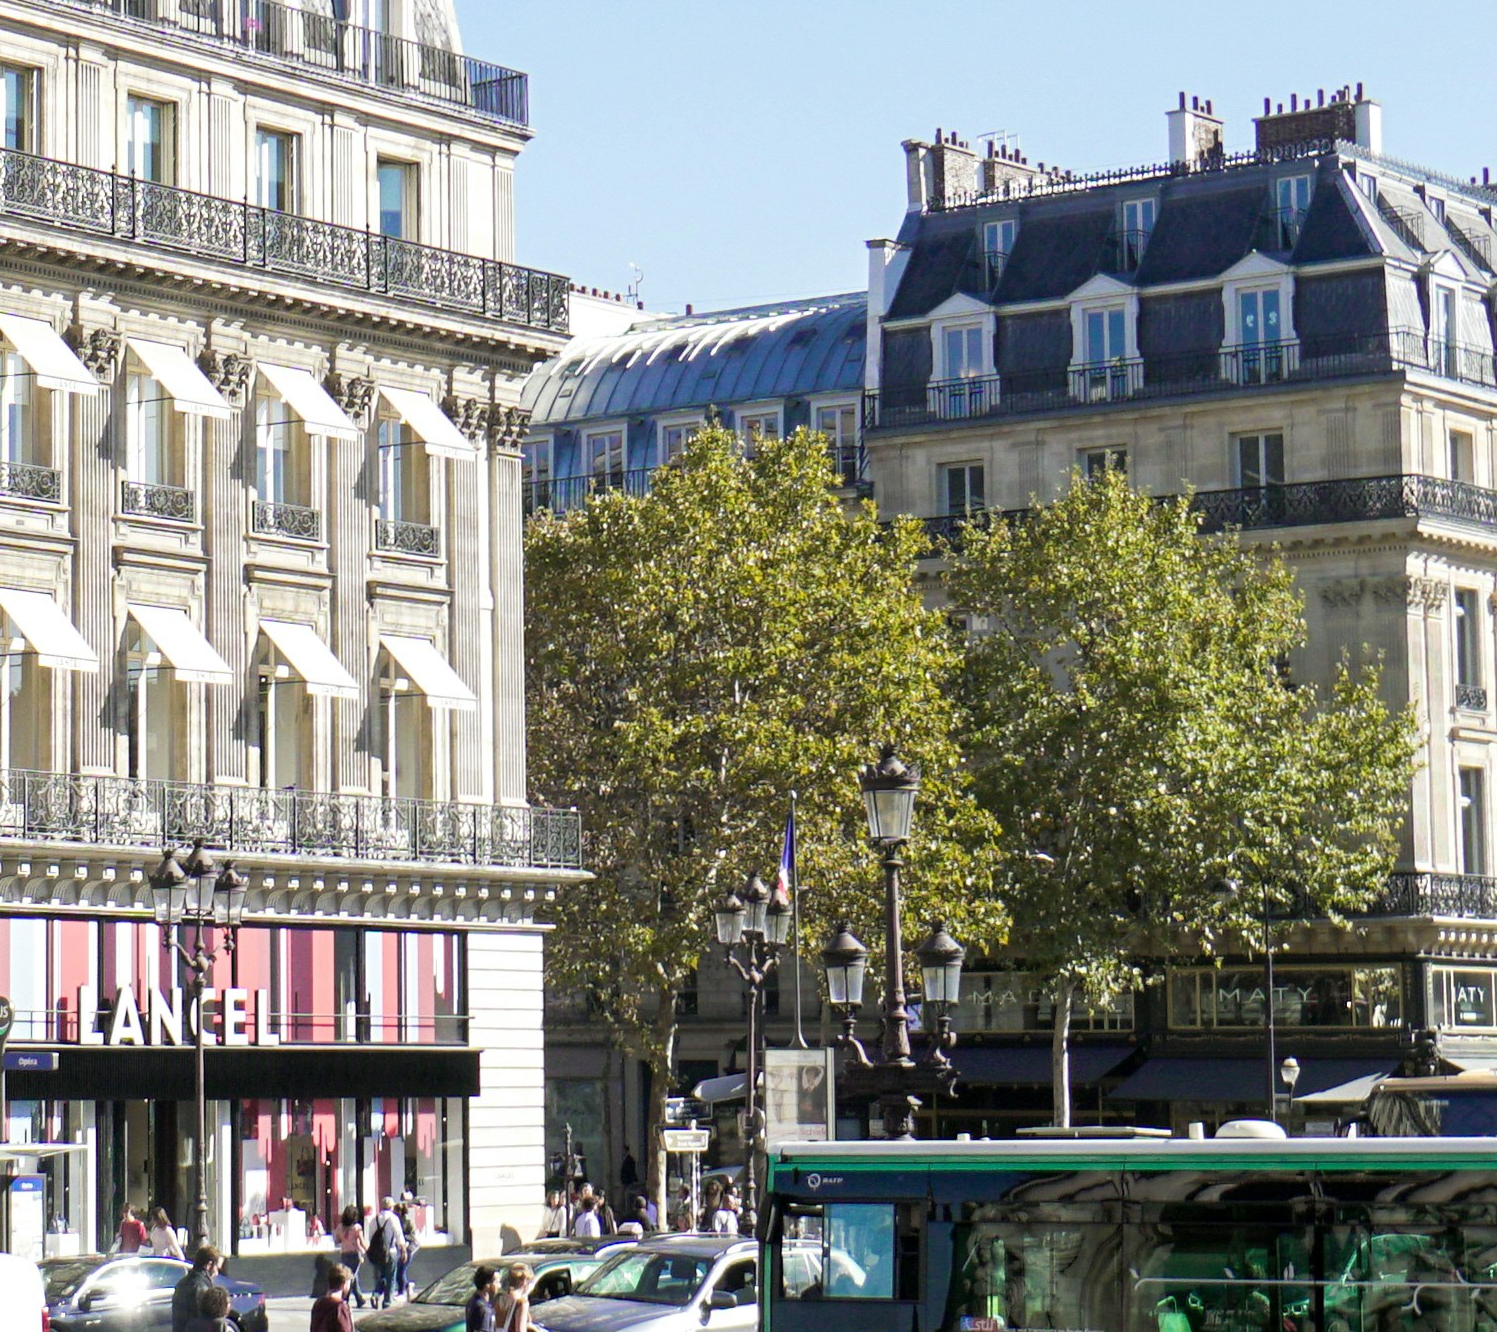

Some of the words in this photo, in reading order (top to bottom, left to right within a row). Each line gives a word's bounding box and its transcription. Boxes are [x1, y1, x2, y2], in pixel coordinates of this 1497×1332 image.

[1218, 986, 1314, 1003] MATY
[1453, 986, 1486, 1003] ATY
[79, 985, 280, 1045] LANCEL
